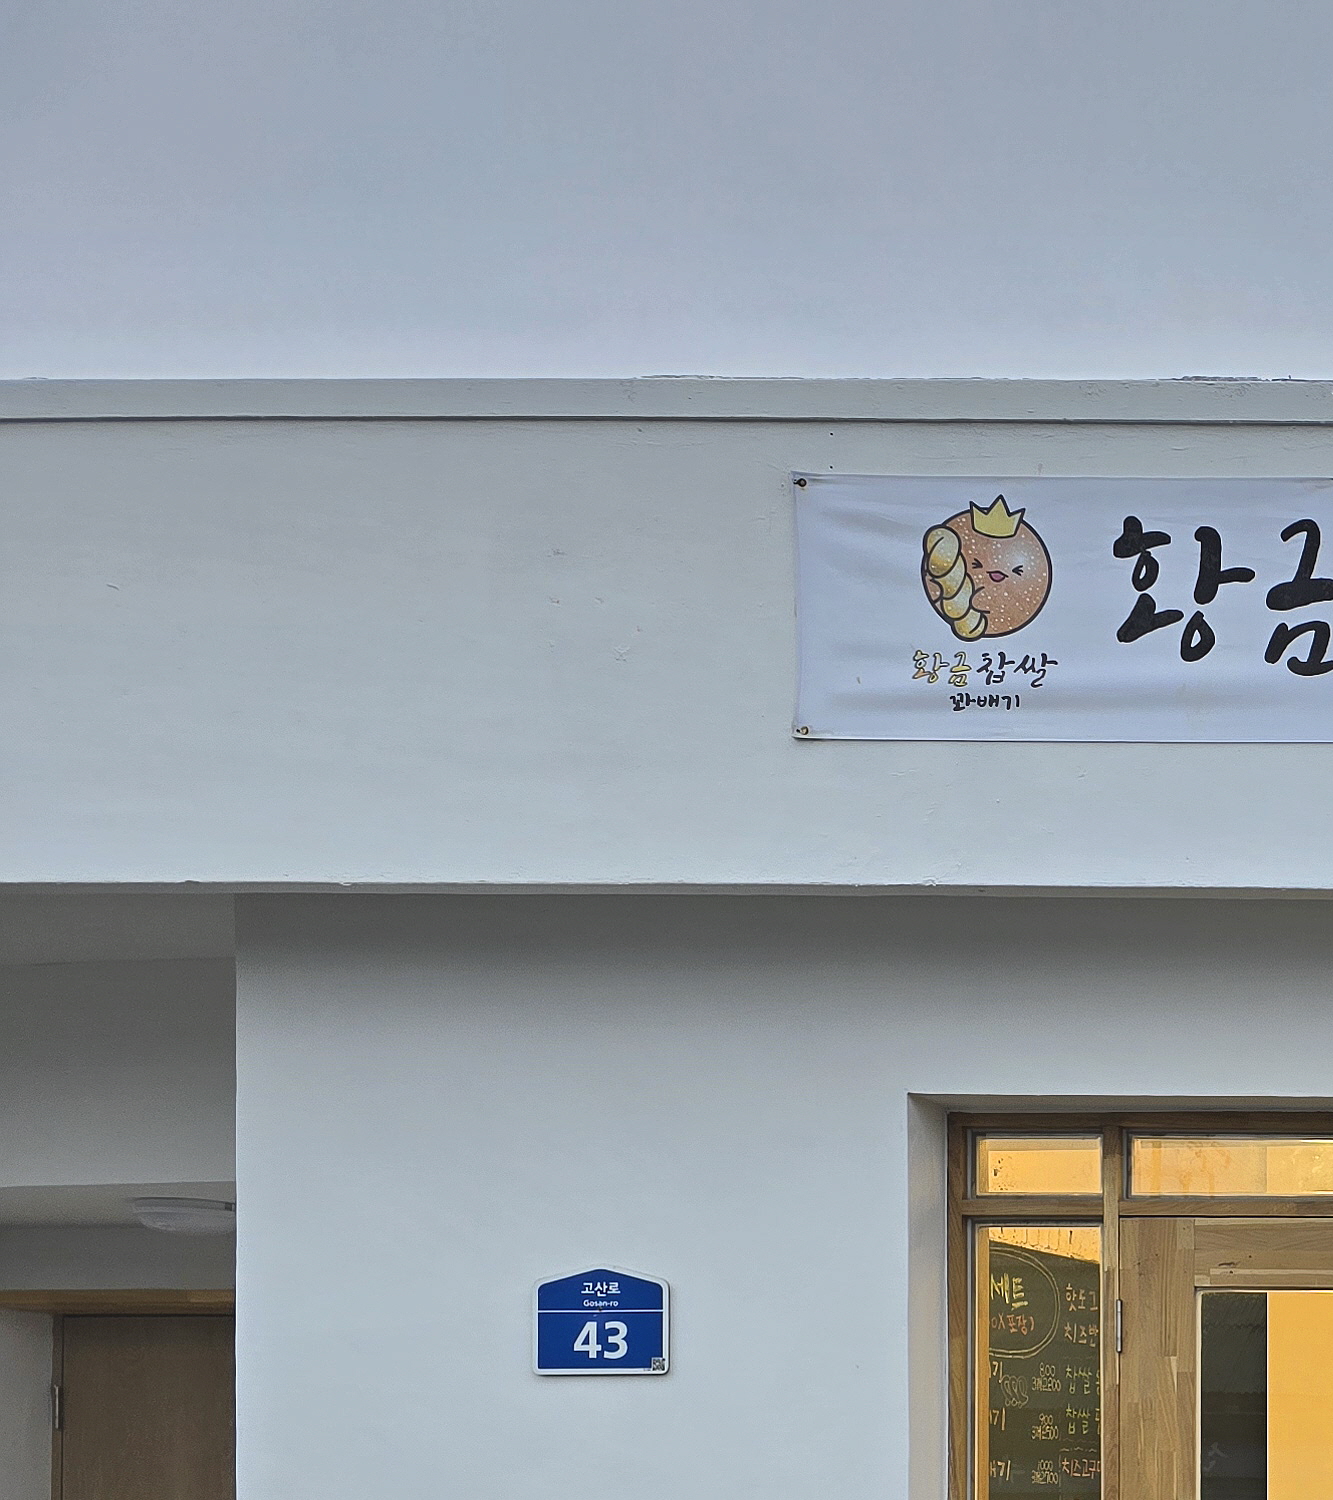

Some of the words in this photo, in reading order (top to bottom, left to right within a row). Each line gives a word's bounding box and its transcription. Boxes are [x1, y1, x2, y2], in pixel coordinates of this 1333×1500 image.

[912, 649, 1059, 688] 황금찹쌀
[949, 692, 1021, 712] 꽈배기
[581, 1282, 621, 1297] 고산로
[583, 1299, 619, 1308] Gosan-ro
[573, 1320, 629, 1360] 43
